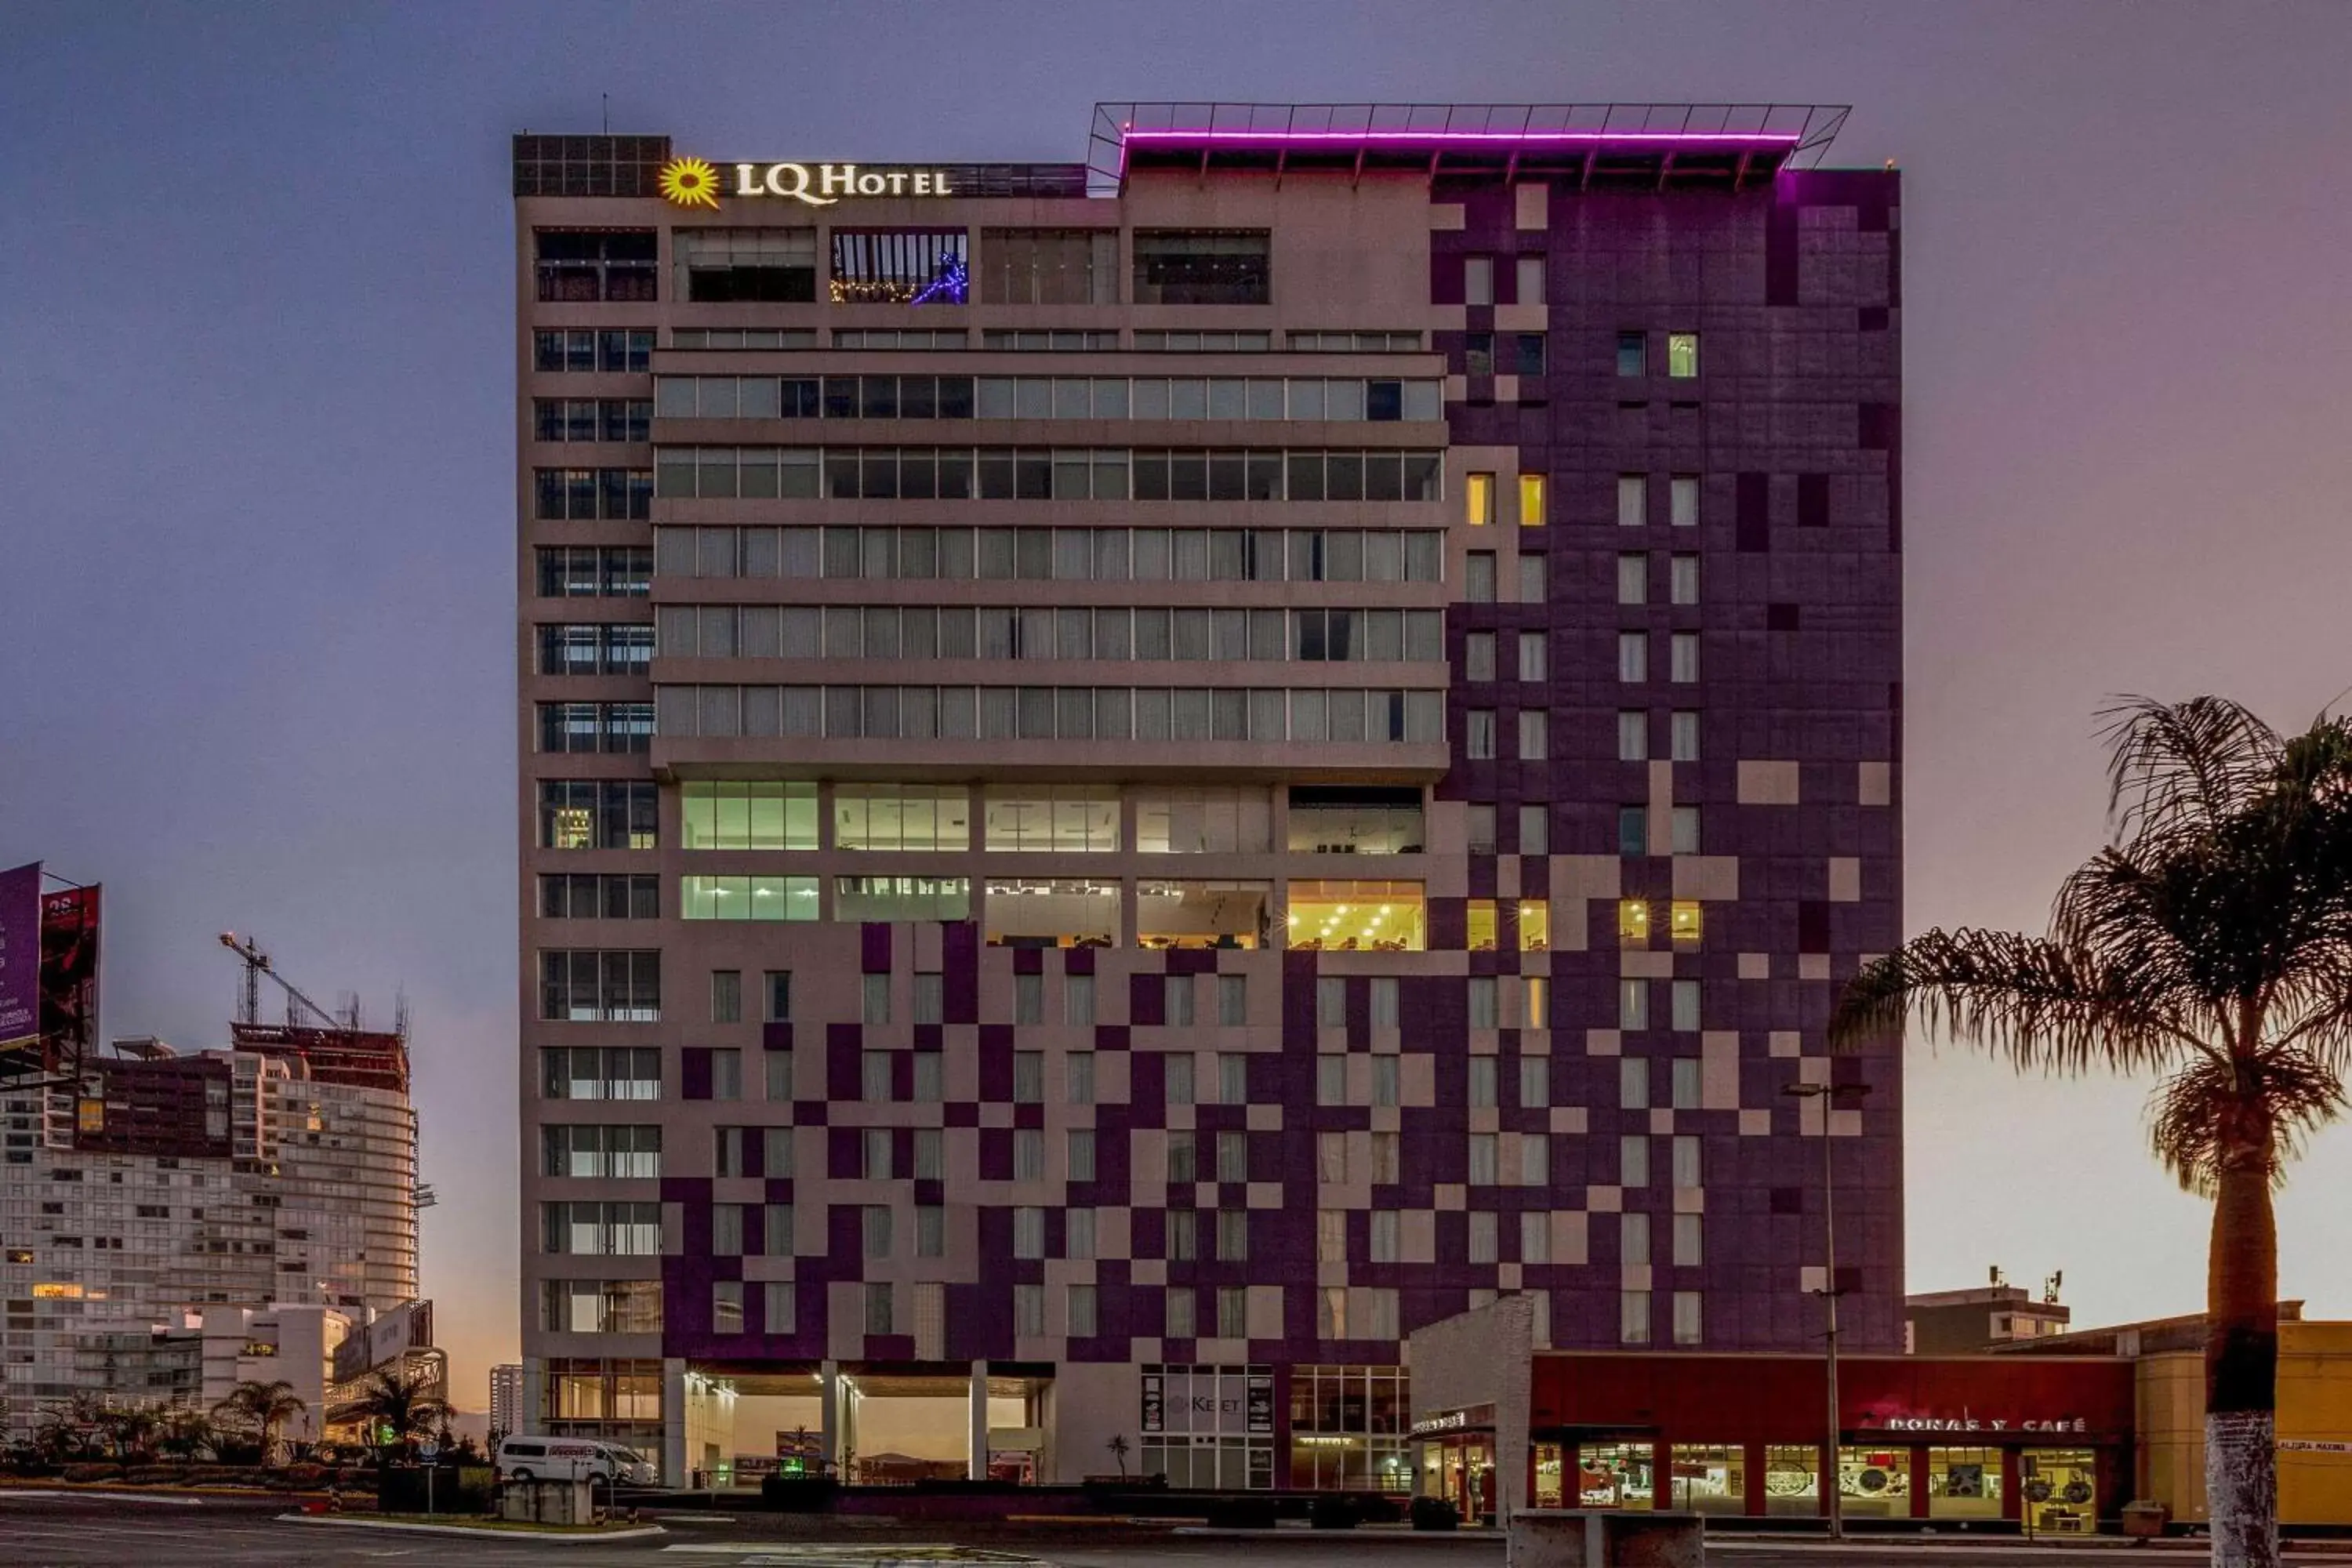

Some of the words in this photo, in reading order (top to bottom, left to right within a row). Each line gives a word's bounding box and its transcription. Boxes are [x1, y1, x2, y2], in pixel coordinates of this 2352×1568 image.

[736, 163, 838, 205] LQ
[820, 165, 953, 194] HOTEL
[1888, 1418, 1980, 1431] DONAS
[1992, 1419, 2008, 1431] Y
[2023, 1417, 2086, 1432] CAFÉ
